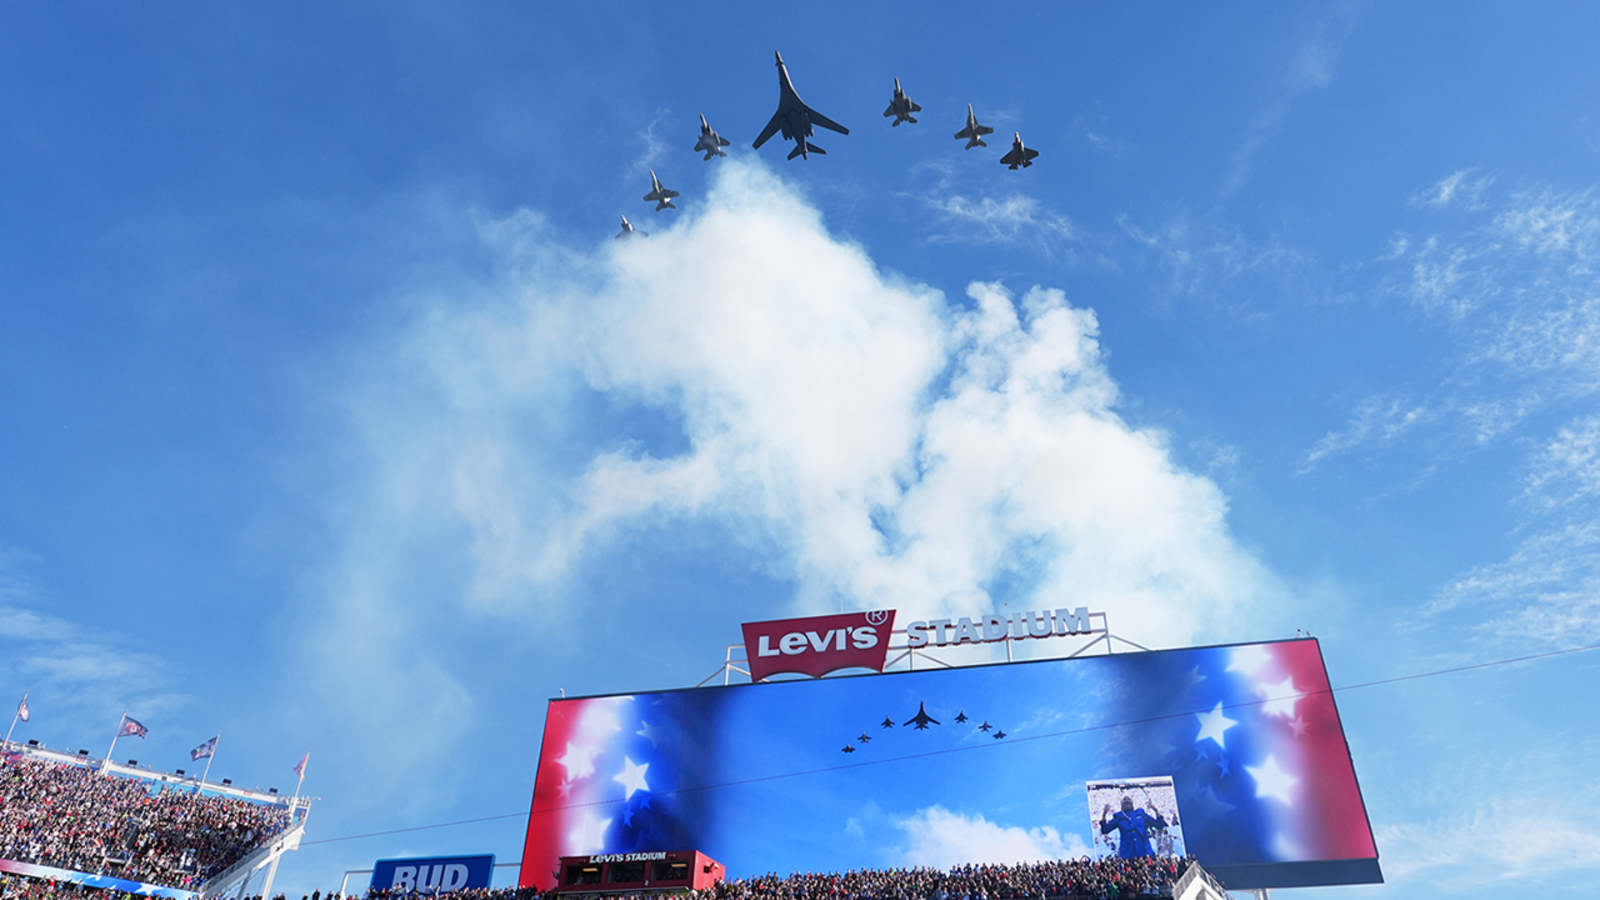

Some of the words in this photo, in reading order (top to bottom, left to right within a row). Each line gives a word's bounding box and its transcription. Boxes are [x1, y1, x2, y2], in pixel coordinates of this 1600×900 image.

[908, 606, 1090, 649] STADIUM
[625, 851, 667, 862] STADIUM
[391, 864, 469, 895] BUD
